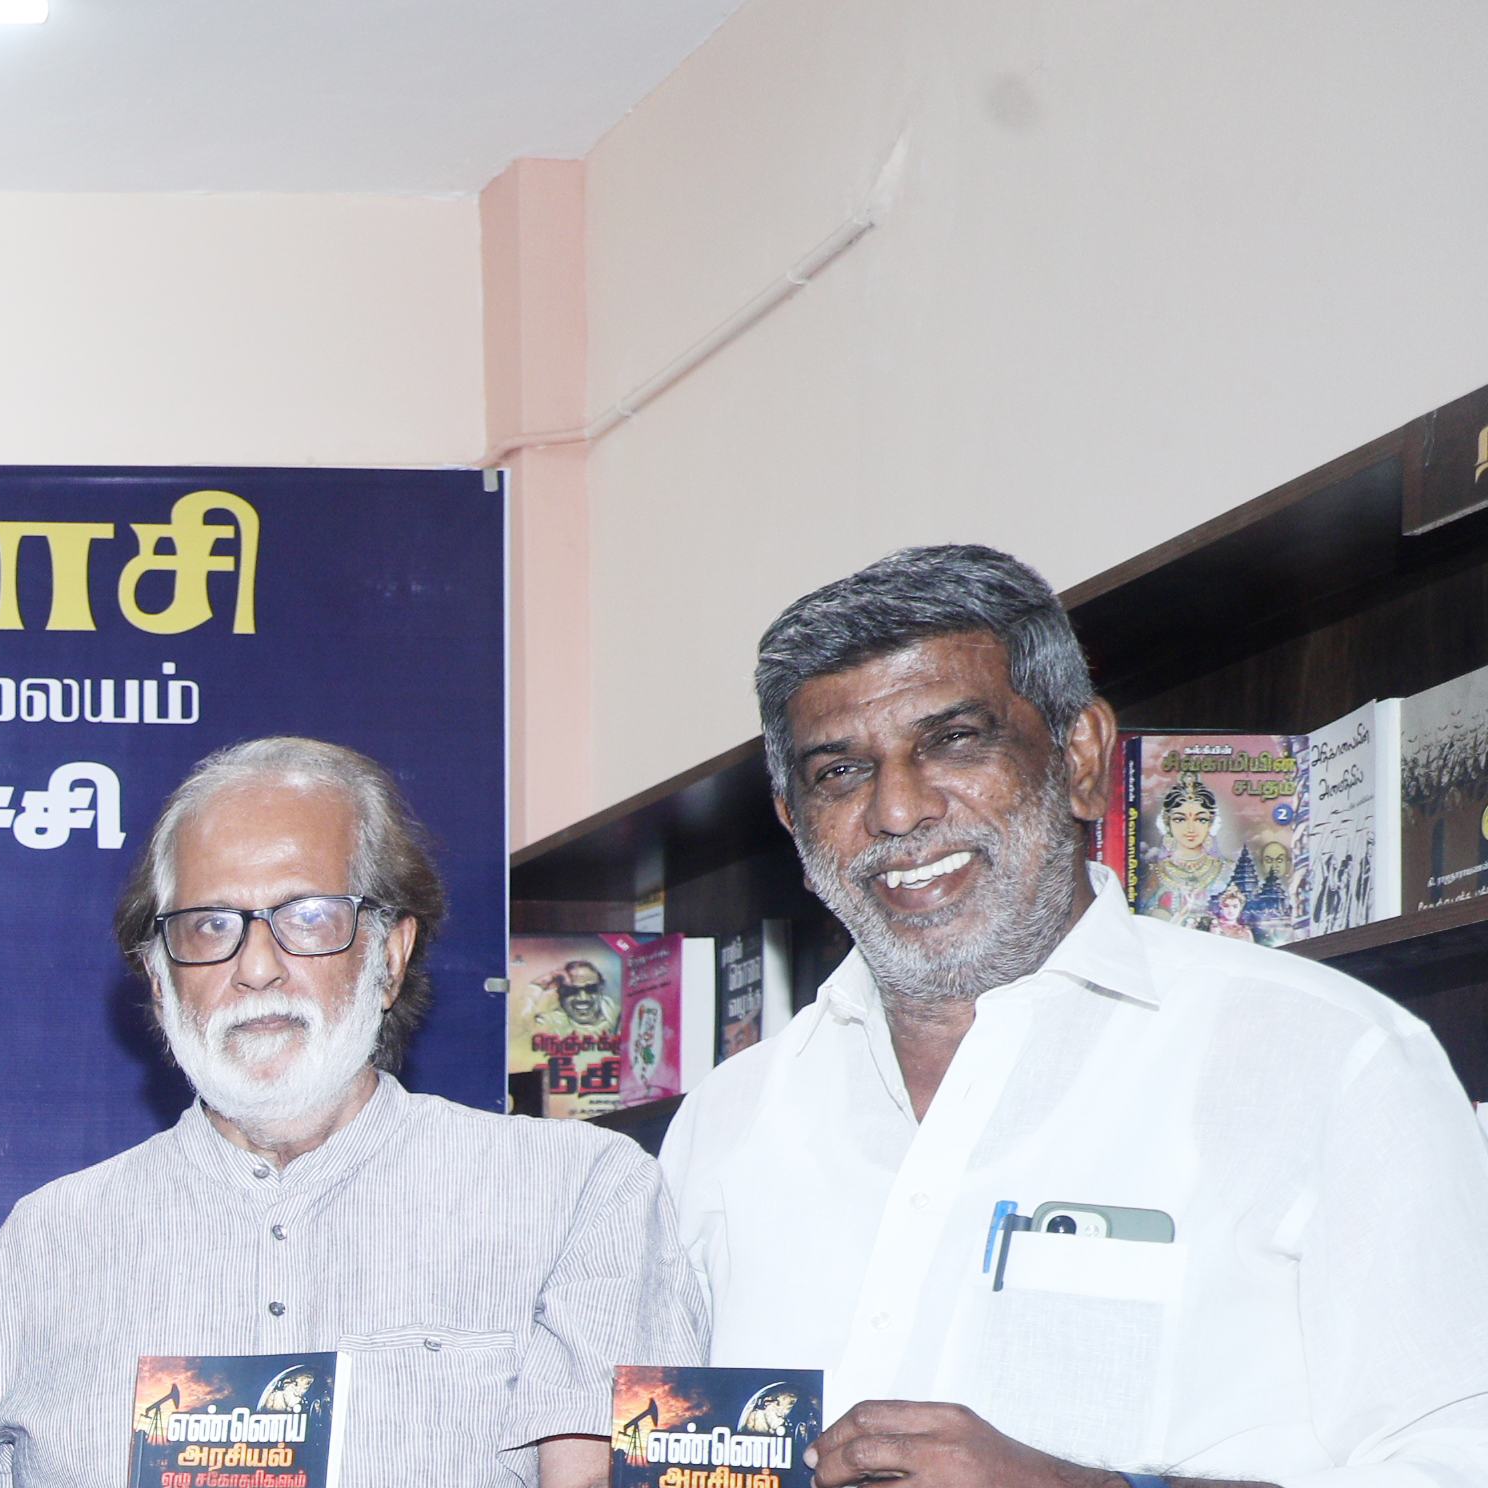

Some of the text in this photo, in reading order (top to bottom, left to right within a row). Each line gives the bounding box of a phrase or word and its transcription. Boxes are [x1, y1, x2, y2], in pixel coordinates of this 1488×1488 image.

[1162, 750, 1297, 773] சிவகாமியின்
[1232, 776, 1296, 801] சபதம்
[1277, 808, 1288, 820] 2
[167, 1404, 308, 1443] எண்ணெய்
[177, 1442, 294, 1471] அரசியல்
[647, 1422, 792, 1469] எண்ணெய்
